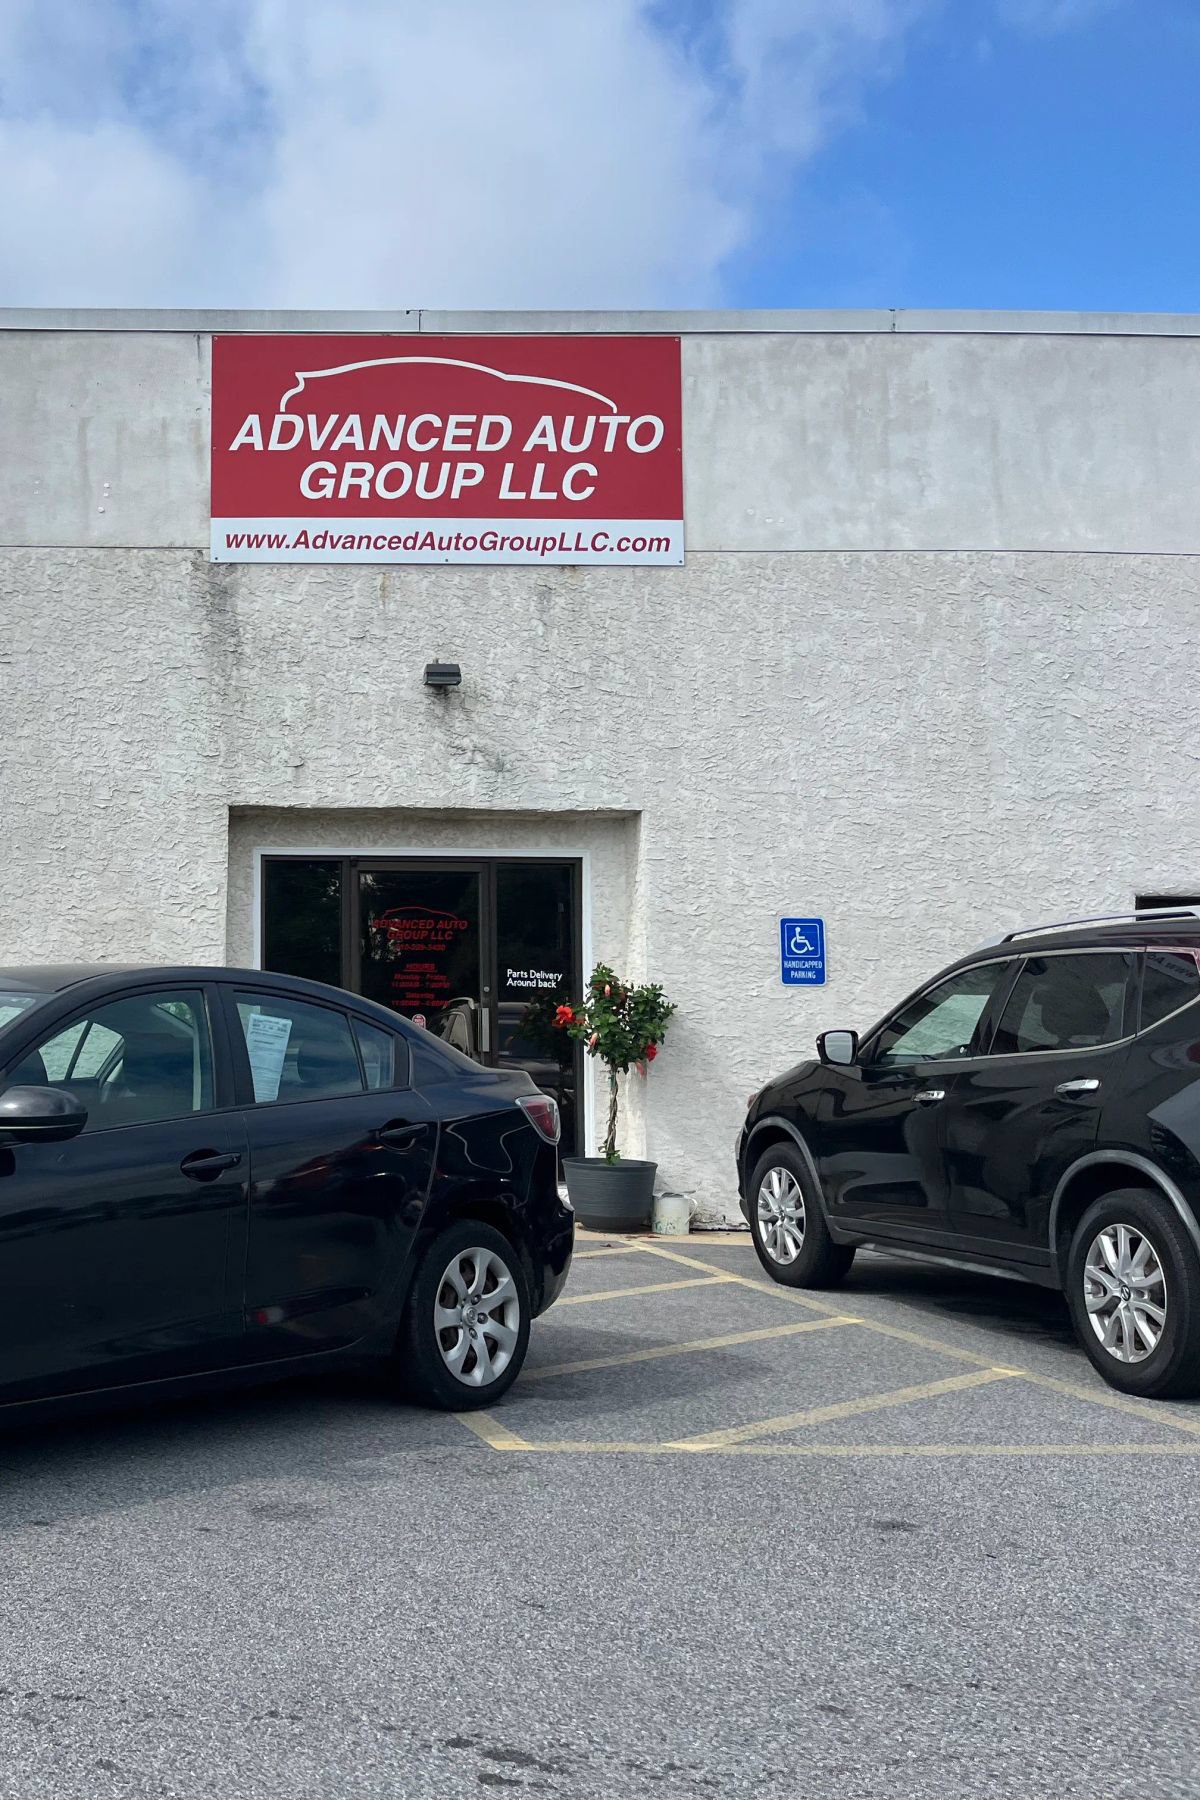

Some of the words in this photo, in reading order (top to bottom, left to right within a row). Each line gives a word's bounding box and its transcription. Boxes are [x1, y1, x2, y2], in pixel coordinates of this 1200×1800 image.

[229, 414, 512, 451] ADVANCED
[523, 415, 664, 453] AUTO
[300, 461, 484, 499] GROUP
[499, 463, 597, 500] LLC
[225, 530, 671, 555] www.AdvancedAutoGroupLLC.com
[373, 919, 434, 929] ADVANCED
[436, 920, 468, 930] AUTO
[387, 930, 428, 940] GROUP
[431, 931, 454, 940] LLC
[507, 969, 528, 978] Parts
[530, 970, 563, 981] Delivery
[790, 970, 816, 979] PARKING
[507, 978, 537, 988] Around
[538, 979, 557, 988] back
